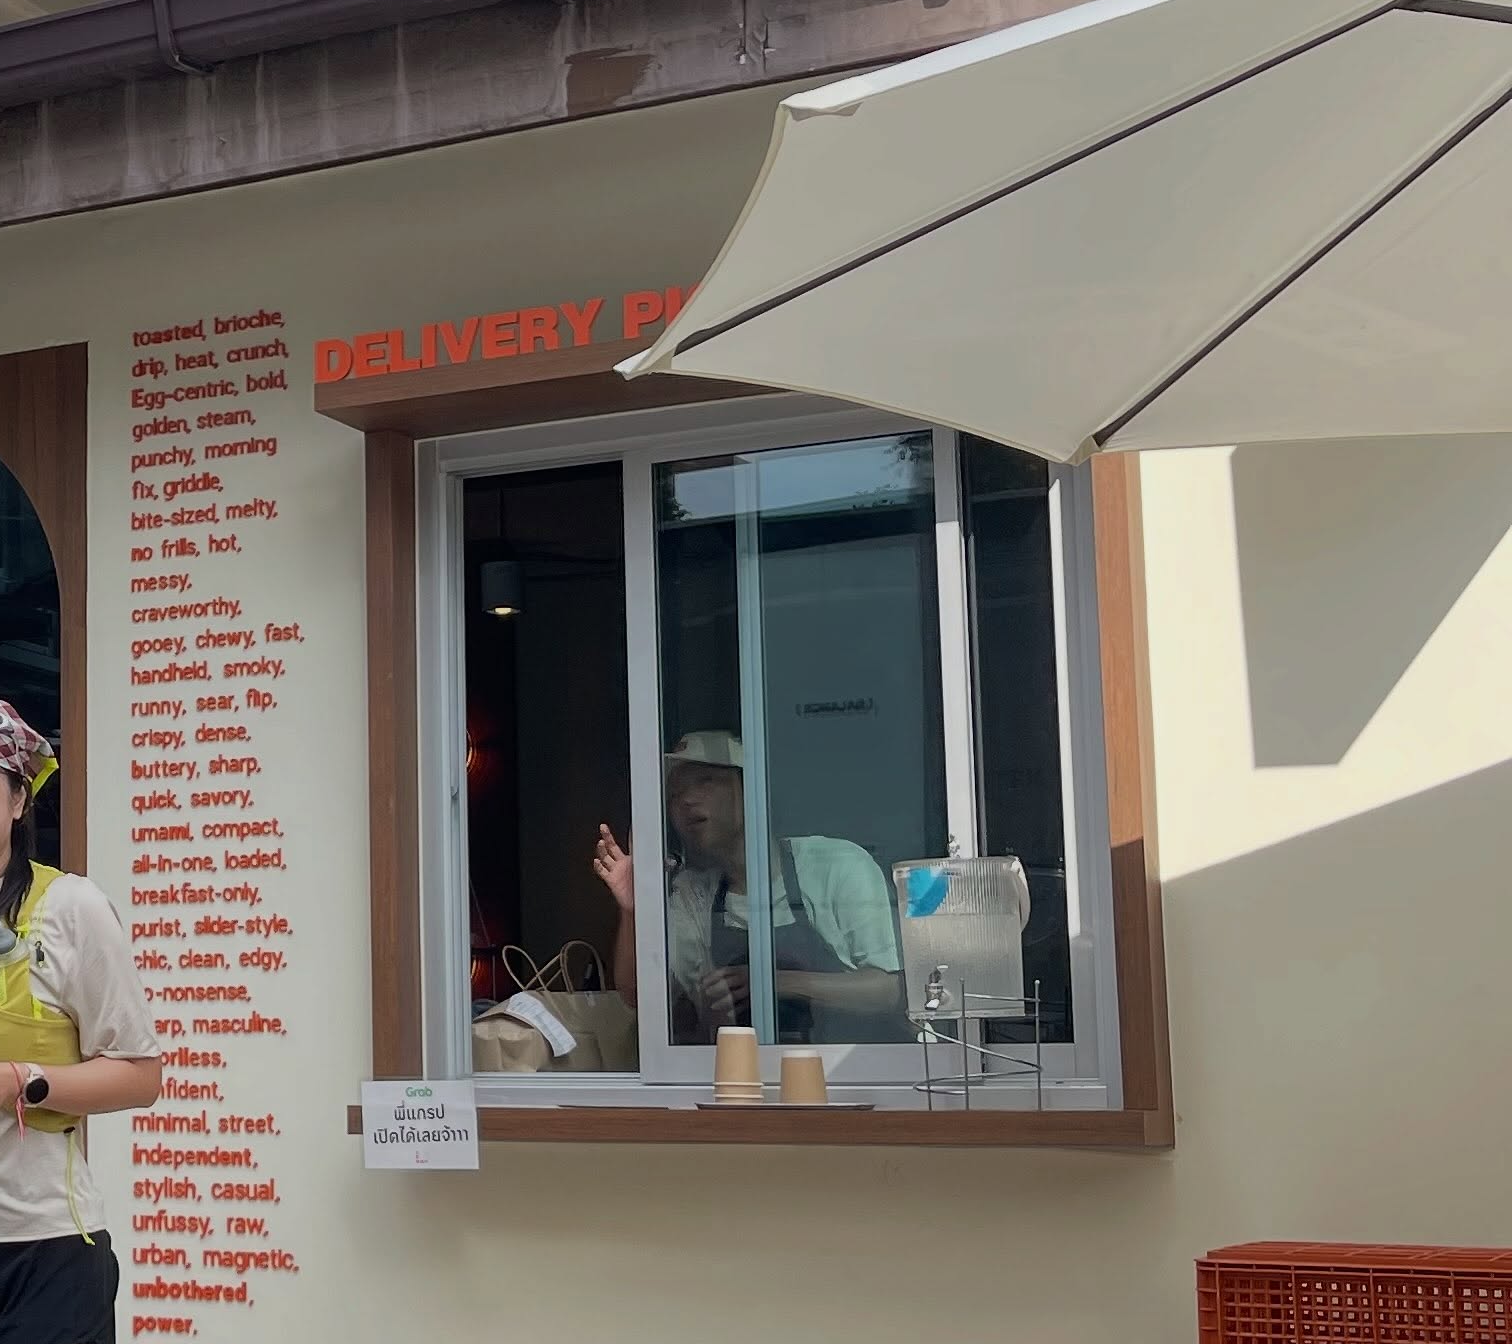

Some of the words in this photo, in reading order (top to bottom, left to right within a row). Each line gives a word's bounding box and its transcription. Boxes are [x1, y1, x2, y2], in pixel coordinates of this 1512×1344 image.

[133, 320, 207, 347] toasted,
[214, 310, 285, 335] brioche,
[314, 296, 606, 384] DELIVERY
[622, 282, 705, 340] PI
[132, 359, 169, 379] drip,
[176, 351, 218, 372] heat,
[226, 338, 289, 363] crunch,
[132, 380, 239, 409] Egg-centric,
[246, 369, 288, 392] bold,
[132, 414, 192, 442] golden,
[197, 408, 256, 429] steam,
[132, 446, 196, 473] punchy,
[205, 435, 277, 460] morning
[164, 472, 224, 501] griddle,
[131, 504, 219, 530] bite-sized,
[226, 498, 278, 520] melty,
[131, 546, 153, 562] no
[161, 537, 200, 558] frills,
[209, 534, 242, 555] hot,
[131, 572, 192, 593] messy,
[132, 596, 242, 624] craveworthy,
[131, 635, 187, 658] gooey,
[196, 627, 256, 648] chewy,
[265, 622, 305, 643] fast,
[131, 660, 212, 685] handheld,
[223, 655, 286, 679] smoky,
[131, 699, 187, 717] runny,
[196, 693, 239, 712] sear,
[246, 688, 277, 711] flip,
[132, 728, 186, 750] crispy,
[196, 723, 251, 743] dense,
[131, 759, 200, 780] buttery,
[209, 754, 261, 775] sharp,
[131, 789, 182, 815] quick,
[190, 788, 254, 808] savory,
[132, 821, 194, 843] umami,
[202, 817, 284, 842] compact,
[132, 853, 217, 874] all-in-one,
[225, 848, 287, 871] loaded,
[132, 917, 187, 942] purist,
[194, 913, 293, 938] slider-style,
[134, 950, 172, 970] chic,
[179, 950, 230, 970] clean,
[239, 947, 287, 971] edgy,
[144, 985, 252, 1002] o-nonsense,
[155, 1017, 186, 1038] arp,
[193, 1011, 287, 1037] masculine,
[160, 1046, 227, 1068] ortless,
[405, 1086, 433, 1097] Grab
[132, 1110, 210, 1135] minimal,
[219, 1114, 281, 1135] street,
[132, 1143, 258, 1170] independent,
[133, 1176, 202, 1205] stylish,
[210, 1178, 280, 1205] casual,
[132, 1209, 214, 1240] unfussy,
[226, 1215, 269, 1238] raw,
[132, 1243, 192, 1268] urban,
[202, 1248, 300, 1275] magnetic,
[132, 1276, 254, 1308] unbothered,
[132, 1315, 198, 1337] power,
